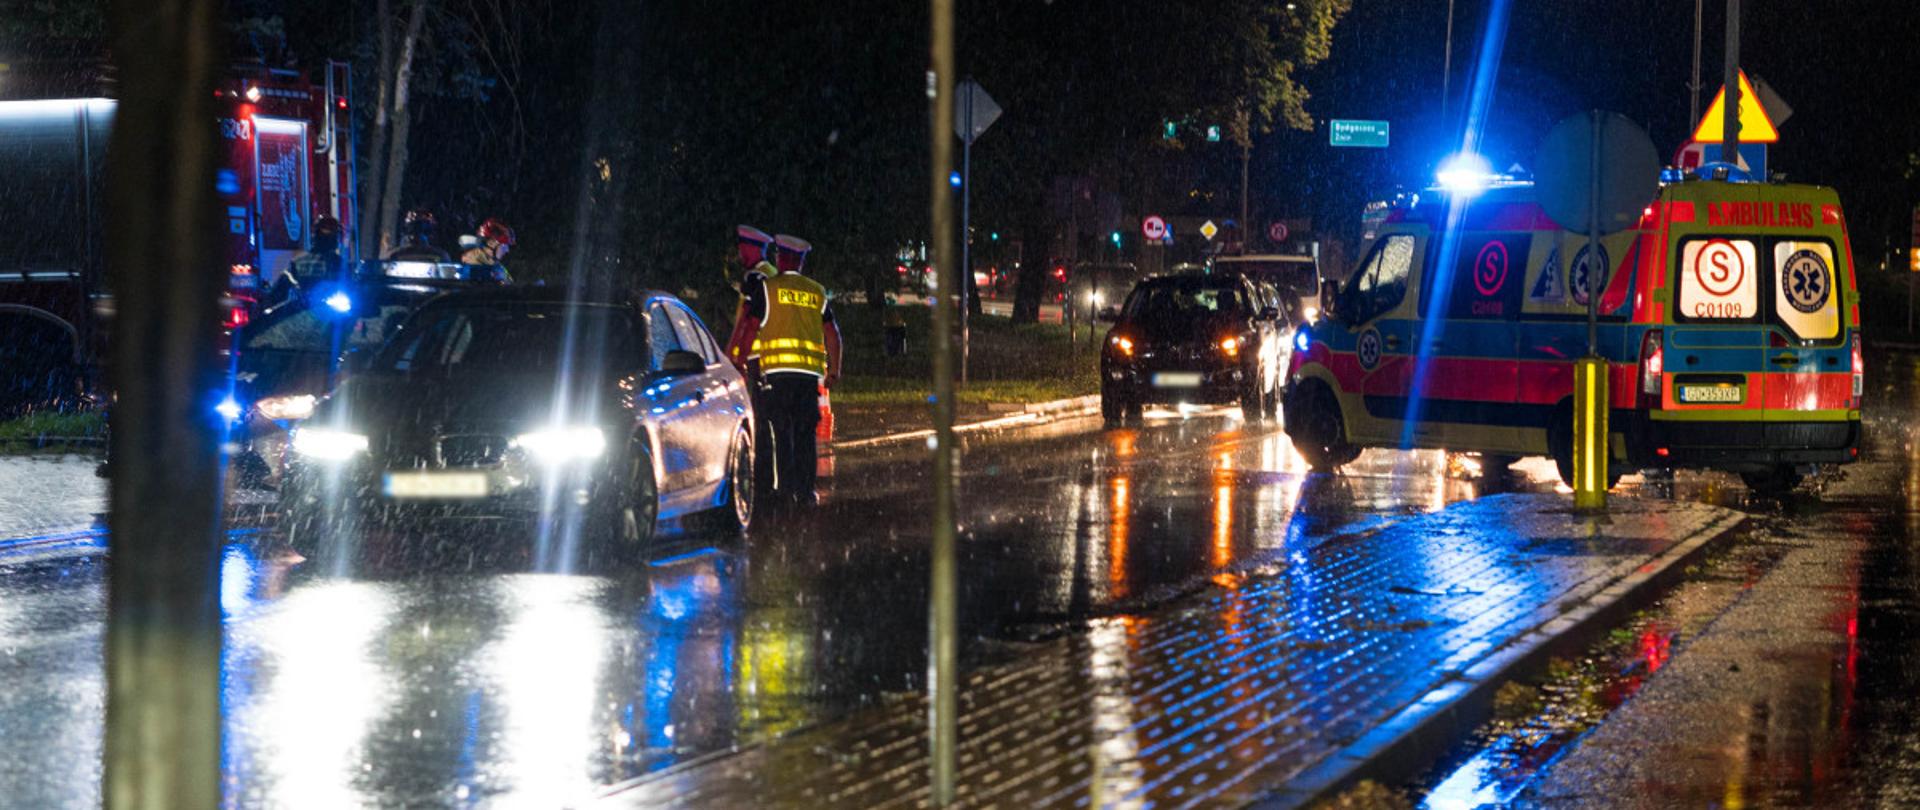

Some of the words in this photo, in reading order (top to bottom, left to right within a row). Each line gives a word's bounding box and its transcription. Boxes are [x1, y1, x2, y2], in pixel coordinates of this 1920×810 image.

[1707, 201, 1814, 229] AMBULANS
[1483, 251, 1499, 283] S
[1710, 250, 1729, 283] S
[780, 290, 818, 306] POLICJA
[1695, 302, 1742, 318] C0109
